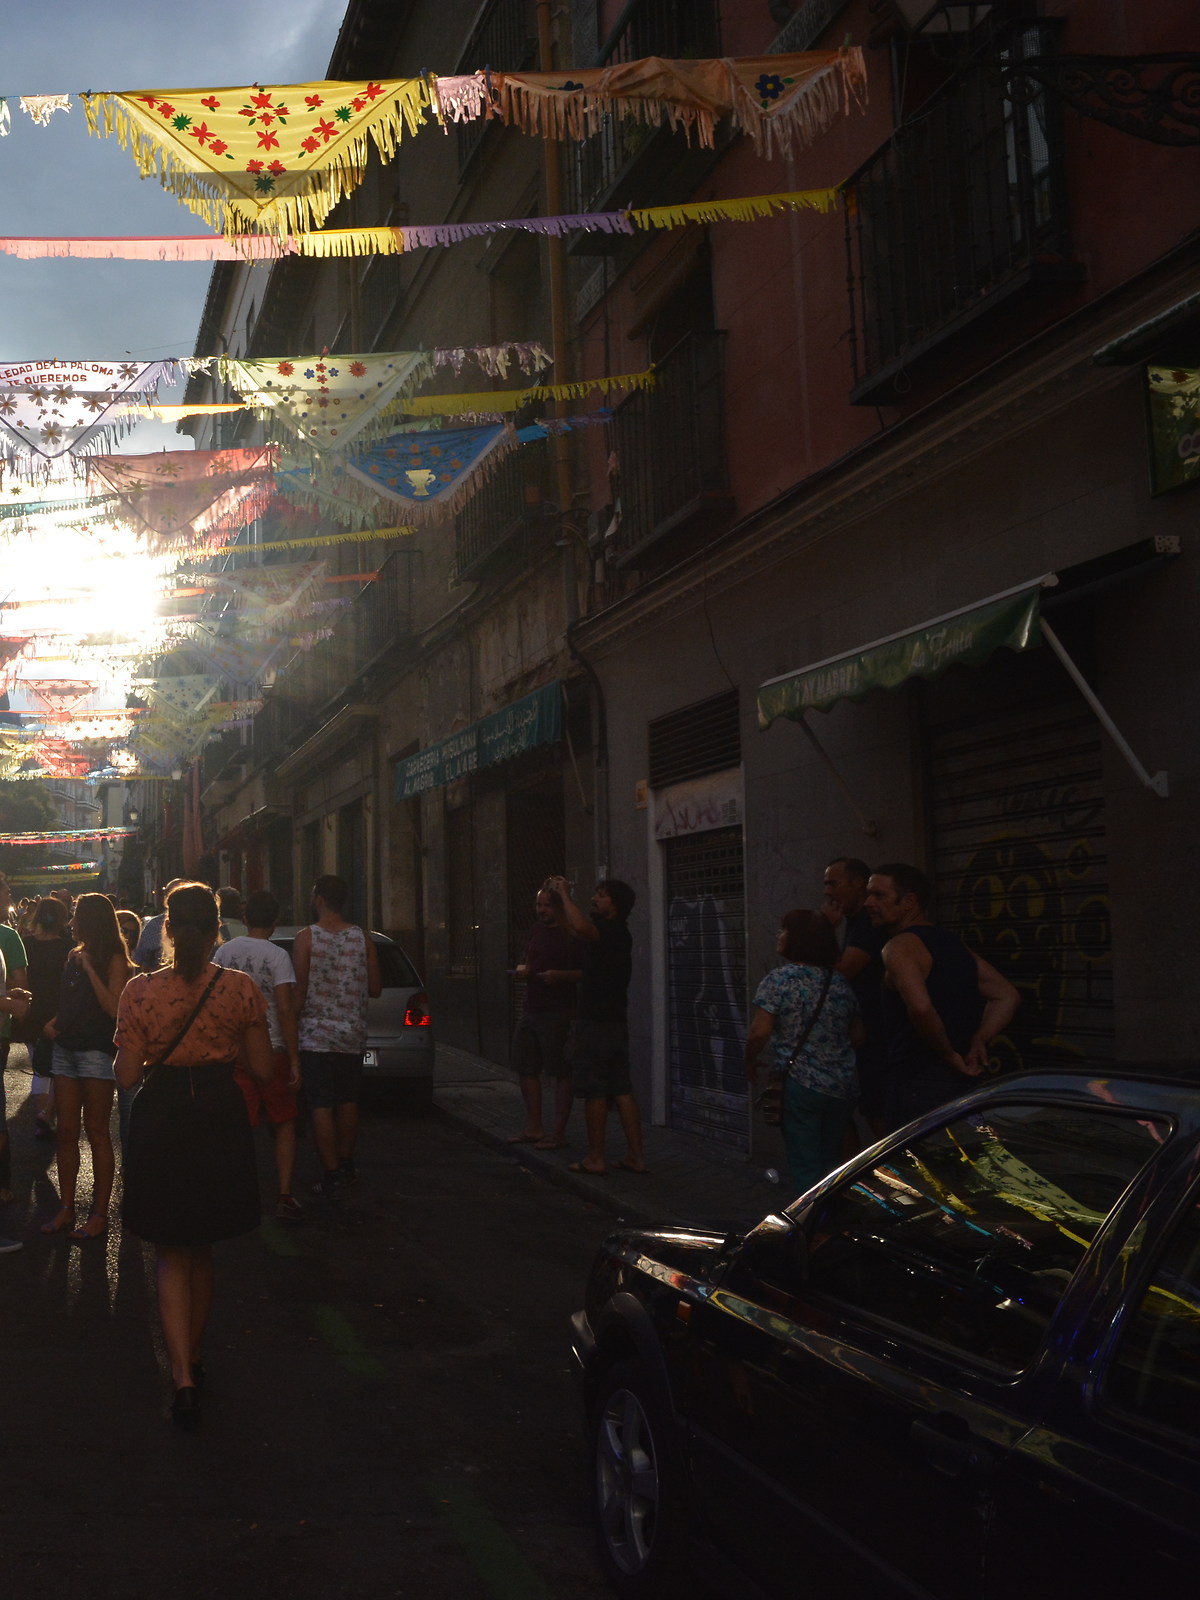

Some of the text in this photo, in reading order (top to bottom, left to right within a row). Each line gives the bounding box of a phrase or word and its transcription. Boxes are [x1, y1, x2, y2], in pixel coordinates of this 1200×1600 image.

[36, 362, 50, 371] DE
[71, 362, 114, 376] PALOMA
[24, 374, 87, 385] QUEREMOS
